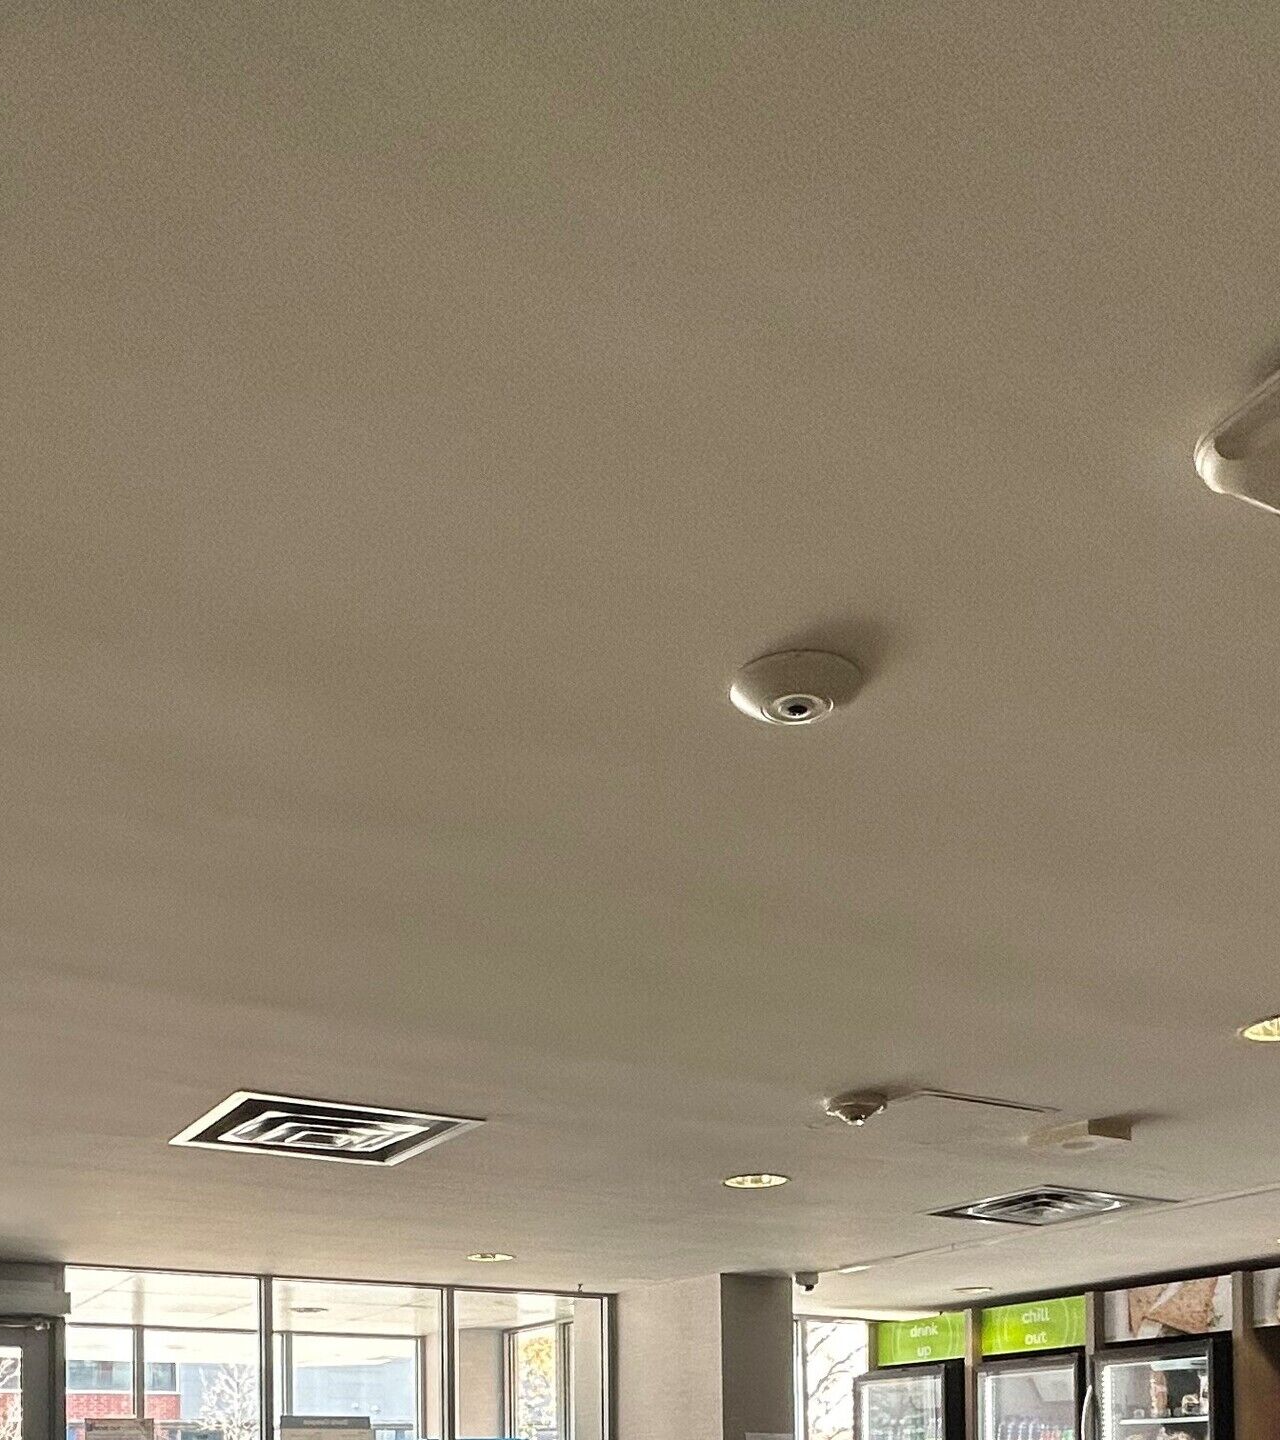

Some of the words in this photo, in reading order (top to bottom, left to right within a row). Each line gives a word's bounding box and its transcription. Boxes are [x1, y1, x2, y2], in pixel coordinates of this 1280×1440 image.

[1022, 1307, 1051, 1324] chill
[909, 1321, 939, 1338] drink
[1024, 1332, 1048, 1345] out
[916, 1344, 932, 1359] up
